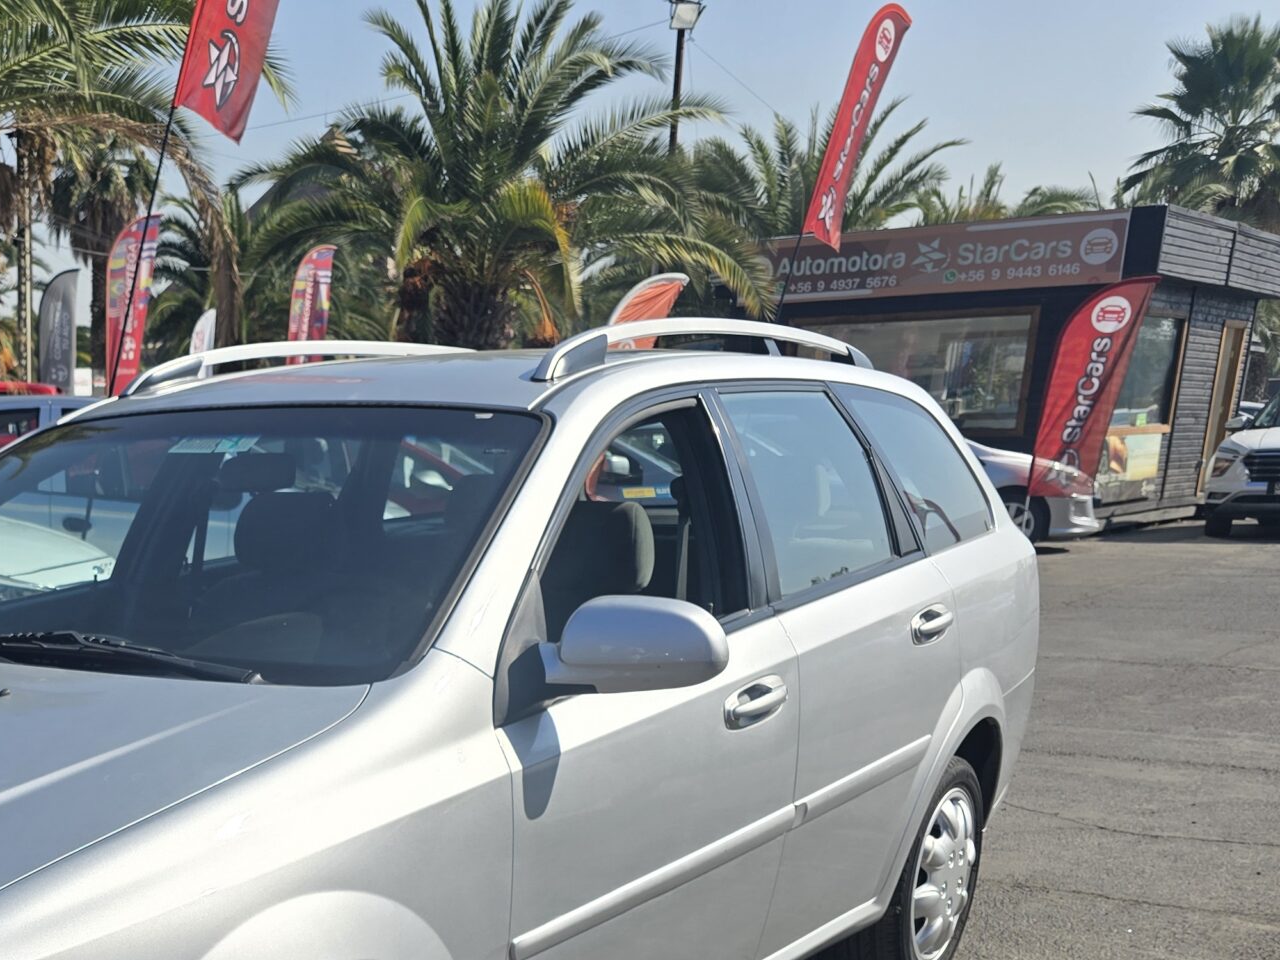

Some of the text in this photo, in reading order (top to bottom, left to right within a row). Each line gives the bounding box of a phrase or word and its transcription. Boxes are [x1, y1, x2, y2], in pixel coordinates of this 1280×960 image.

[776, 239, 1073, 277] Automotora StarCars
[788, 276, 897, 293] +56 9 4937 5676
[958, 263, 1081, 282] +56 9 9443 6146
[1062, 336, 1112, 443] StarCars
